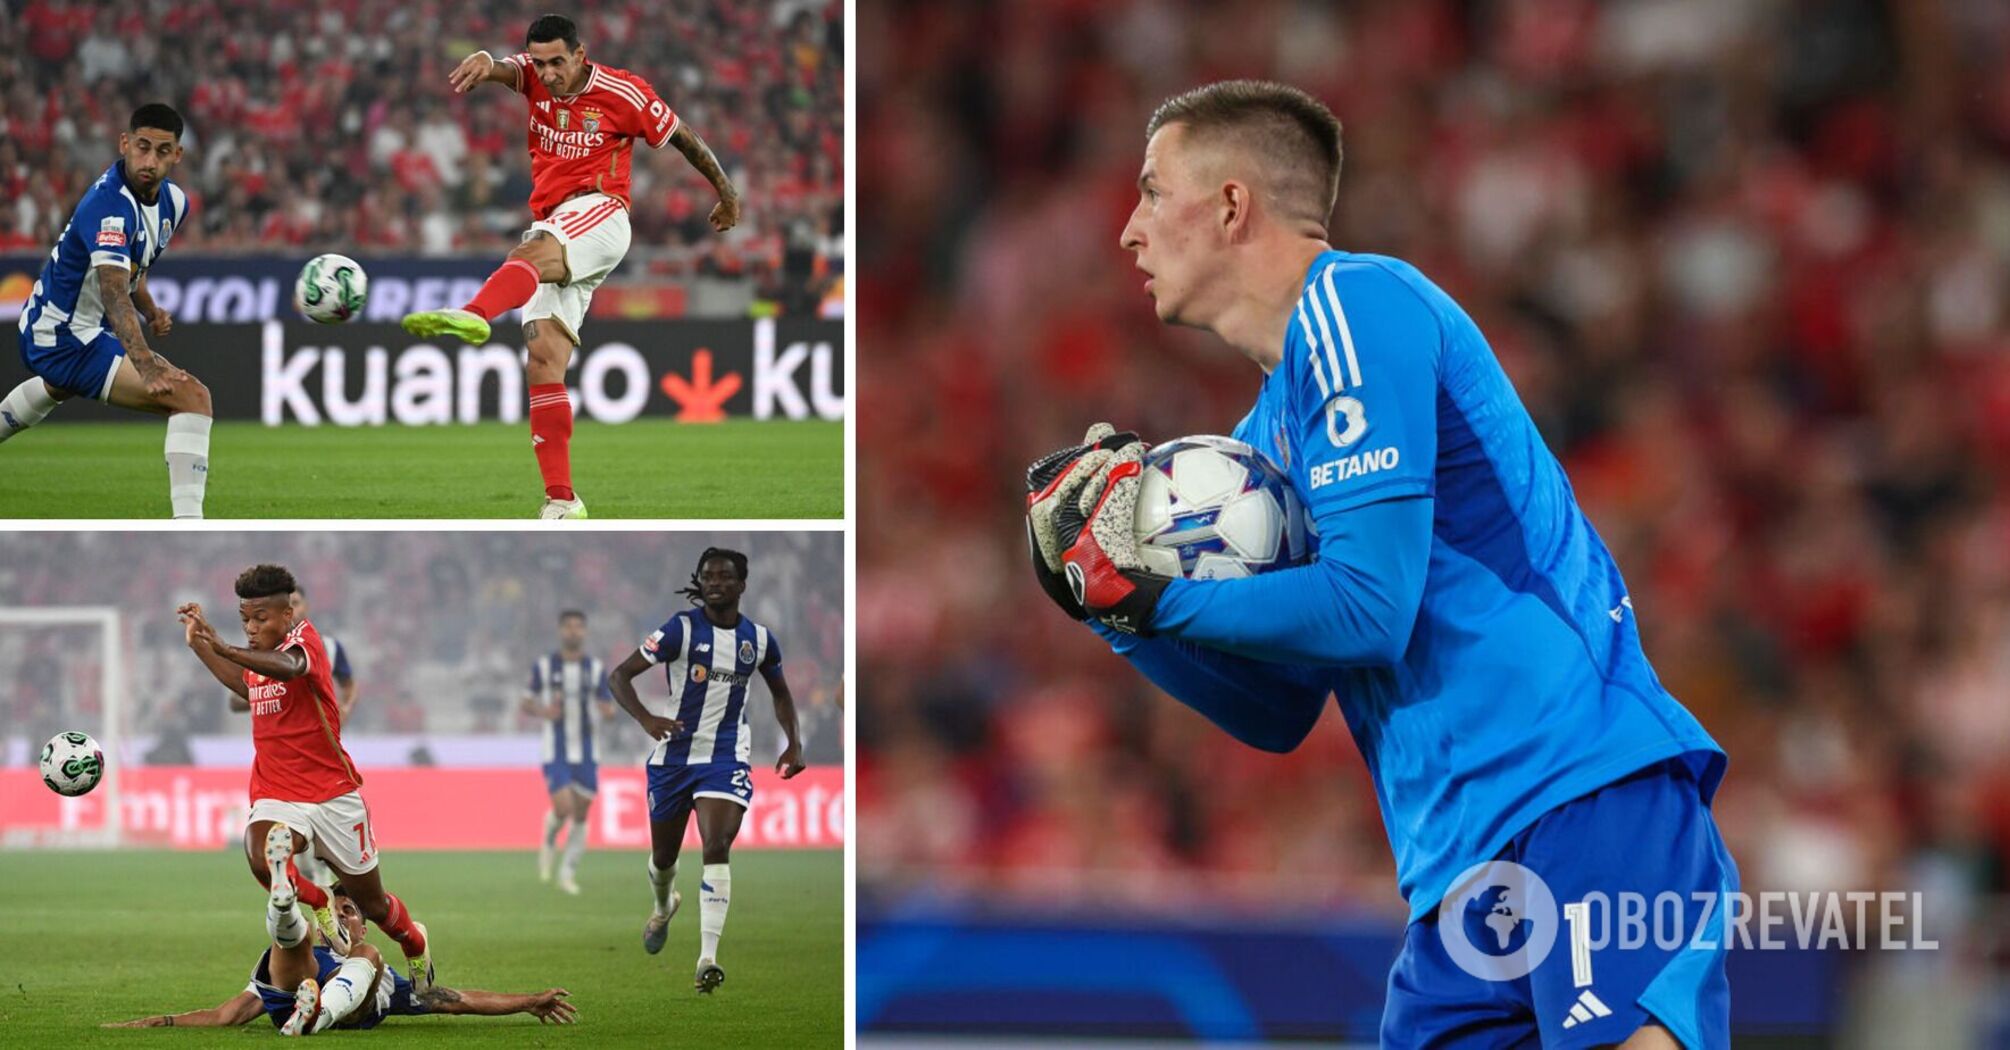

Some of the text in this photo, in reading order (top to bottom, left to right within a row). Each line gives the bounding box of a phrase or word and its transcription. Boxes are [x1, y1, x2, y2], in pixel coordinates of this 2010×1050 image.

[529, 115, 605, 147] Emirates
[540, 136, 554, 153] FLY
[1310, 446, 1400, 490] BETANO
[1564, 902, 1593, 988] 1
